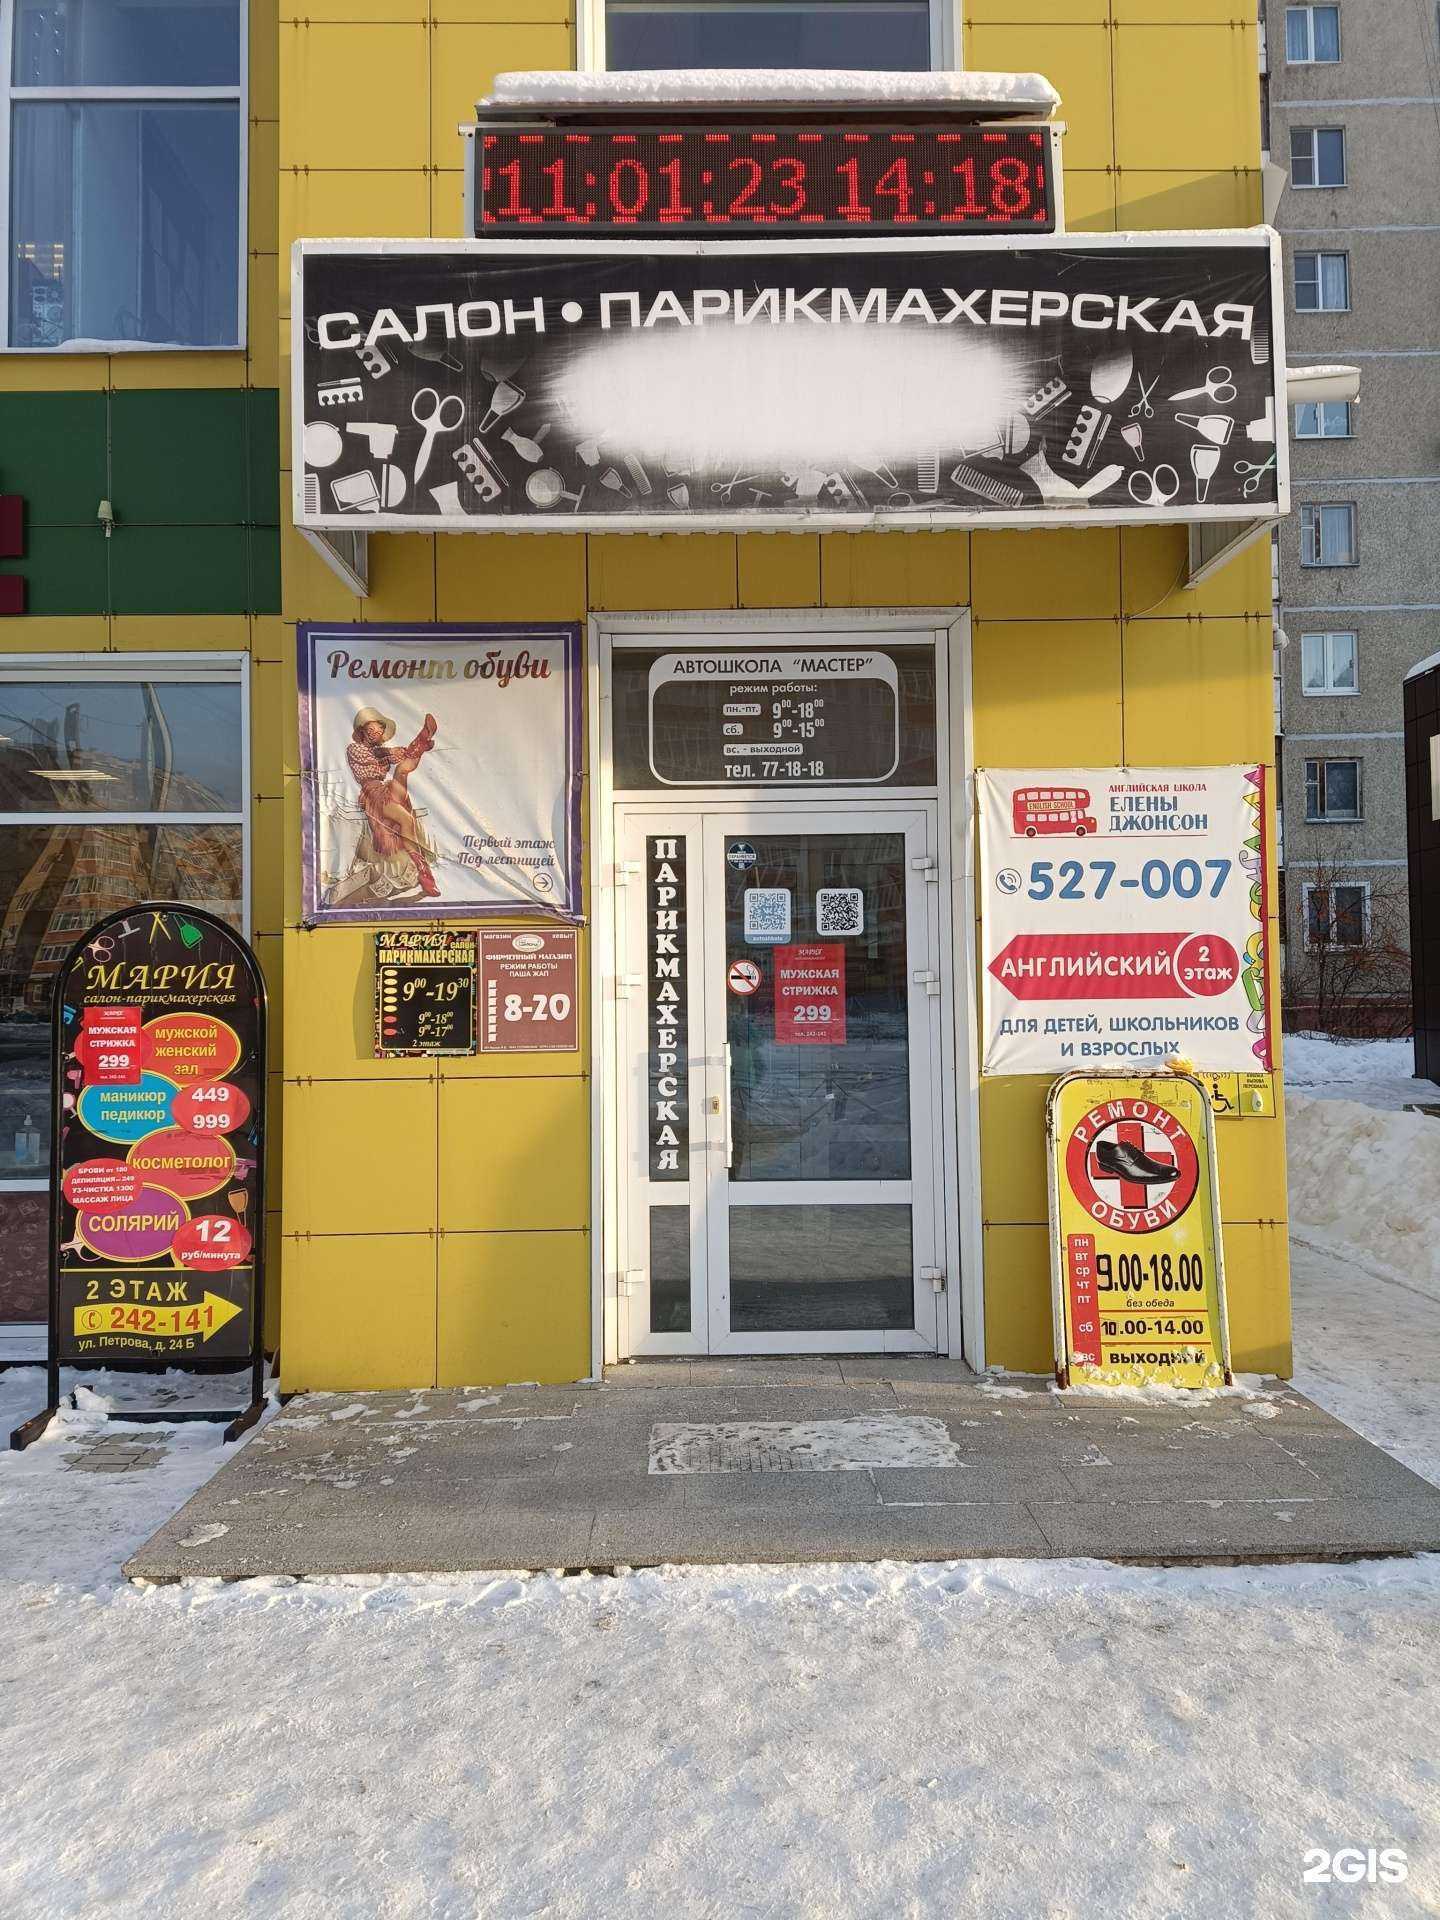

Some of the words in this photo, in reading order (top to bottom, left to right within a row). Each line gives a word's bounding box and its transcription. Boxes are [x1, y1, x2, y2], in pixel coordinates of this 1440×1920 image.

[498, 157, 806, 217] 11:01:23
[837, 157, 1032, 216] 14:18
[317, 296, 545, 351] САЛОН
[600, 287, 1255, 341] ПАРИКМАХЕРСКАЯ
[327, 650, 458, 680] Ремонт
[464, 650, 552, 689] обуви
[673, 659, 783, 674] АВТОШКОЛА
[793, 657, 874, 673] "МАСТЕР"
[729, 684, 769, 697] режим
[772, 683, 818, 695] работы:
[725, 705, 760, 714] пн.-пт.
[725, 723, 741, 736] сб.
[726, 746, 740, 755] вс.
[750, 744, 800, 755] выходной
[724, 764, 756, 779] тел.
[762, 760, 825, 778] 77-18-18
[1109, 783, 1170, 793] АНГЛИЙСКАЯ
[1174, 783, 1207, 792] ШКОЛА
[1110, 796, 1178, 812] ЕЛЕНЫ
[1109, 814, 1208, 832] ДЖОНСОН
[463, 834, 512, 849] Первый
[514, 837, 555, 849] этаж
[457, 851, 483, 866] Под
[485, 851, 555, 868] лестницей
[1028, 859, 1232, 901] 527-007
[379, 933, 449, 949] МАРИЯ
[379, 949, 475, 964] ПАРИКМАХЕРСКАЯ
[1199, 946, 1211, 963] 2
[527, 962, 558, 970] РАБОТЫ
[1001, 951, 1171, 977] АНГЛИЙСКИЙ
[86, 962, 236, 990] МАРИЯ
[780, 969, 840, 979] МУЖСКАЯ
[1184, 967, 1233, 981] этаж
[782, 986, 839, 996] СТРИЖКА
[83, 994, 237, 1005] салон-парикмахерская
[654, 838, 681, 1170] ПАРИКМАХЕРСКАЯ
[503, 993, 571, 1022] 8-20
[793, 1005, 832, 1021] 299
[88, 1026, 137, 1035] МУЖСКАЯ
[1000, 1018, 1038, 1036] ДЛЯ
[1044, 1014, 1103, 1034] ДЕТЕЙ,
[1109, 1015, 1240, 1032] ШКОЛЬНИКОВ
[155, 1026, 217, 1042] мужской
[89, 1039, 136, 1048] СТРИЖКА
[155, 1045, 217, 1057] женский
[412, 1040, 418, 1048] 2
[1061, 1043, 1074, 1056] И
[1081, 1041, 1180, 1056] ВЗРОСЛЫХ
[98, 1054, 130, 1068] 299
[174, 1064, 199, 1075] зал
[100, 1090, 167, 1105] маникюр
[191, 1087, 231, 1101] 449
[100, 1108, 166, 1123] педикюр
[192, 1114, 231, 1129] 999
[1074, 1100, 1186, 1145] РЕМОНТ
[132, 1157, 231, 1170] косметолог
[72, 1196, 109, 1204] МАССАЖ
[89, 1210, 179, 1232] СОЛЯРИЙ
[1091, 1199, 1178, 1230] ОБУВИ
[195, 1219, 232, 1242] 12
[1074, 1238, 1089, 1247] пн
[181, 1251, 241, 1260] руб/минута
[1075, 1252, 1088, 1260] вт
[1075, 1267, 1090, 1277] ср
[1096, 1253, 1203, 1292] 9.00-18.00
[86, 1280, 99, 1300] 2
[110, 1278, 188, 1301] ЭТАЖ
[1077, 1281, 1090, 1289] чт
[1077, 1295, 1091, 1304] пт
[1126, 1298, 1143, 1308] без
[1146, 1298, 1175, 1308] обеда
[110, 1305, 213, 1332] 242-141
[1079, 1321, 1094, 1332] сб
[78, 1338, 96, 1351] ул.
[99, 1336, 152, 1351] Петрова,
[155, 1339, 166, 1350] д.
[169, 1339, 183, 1350] 24
[185, 1338, 195, 1349] Б
[1082, 1353, 1096, 1362] вс
